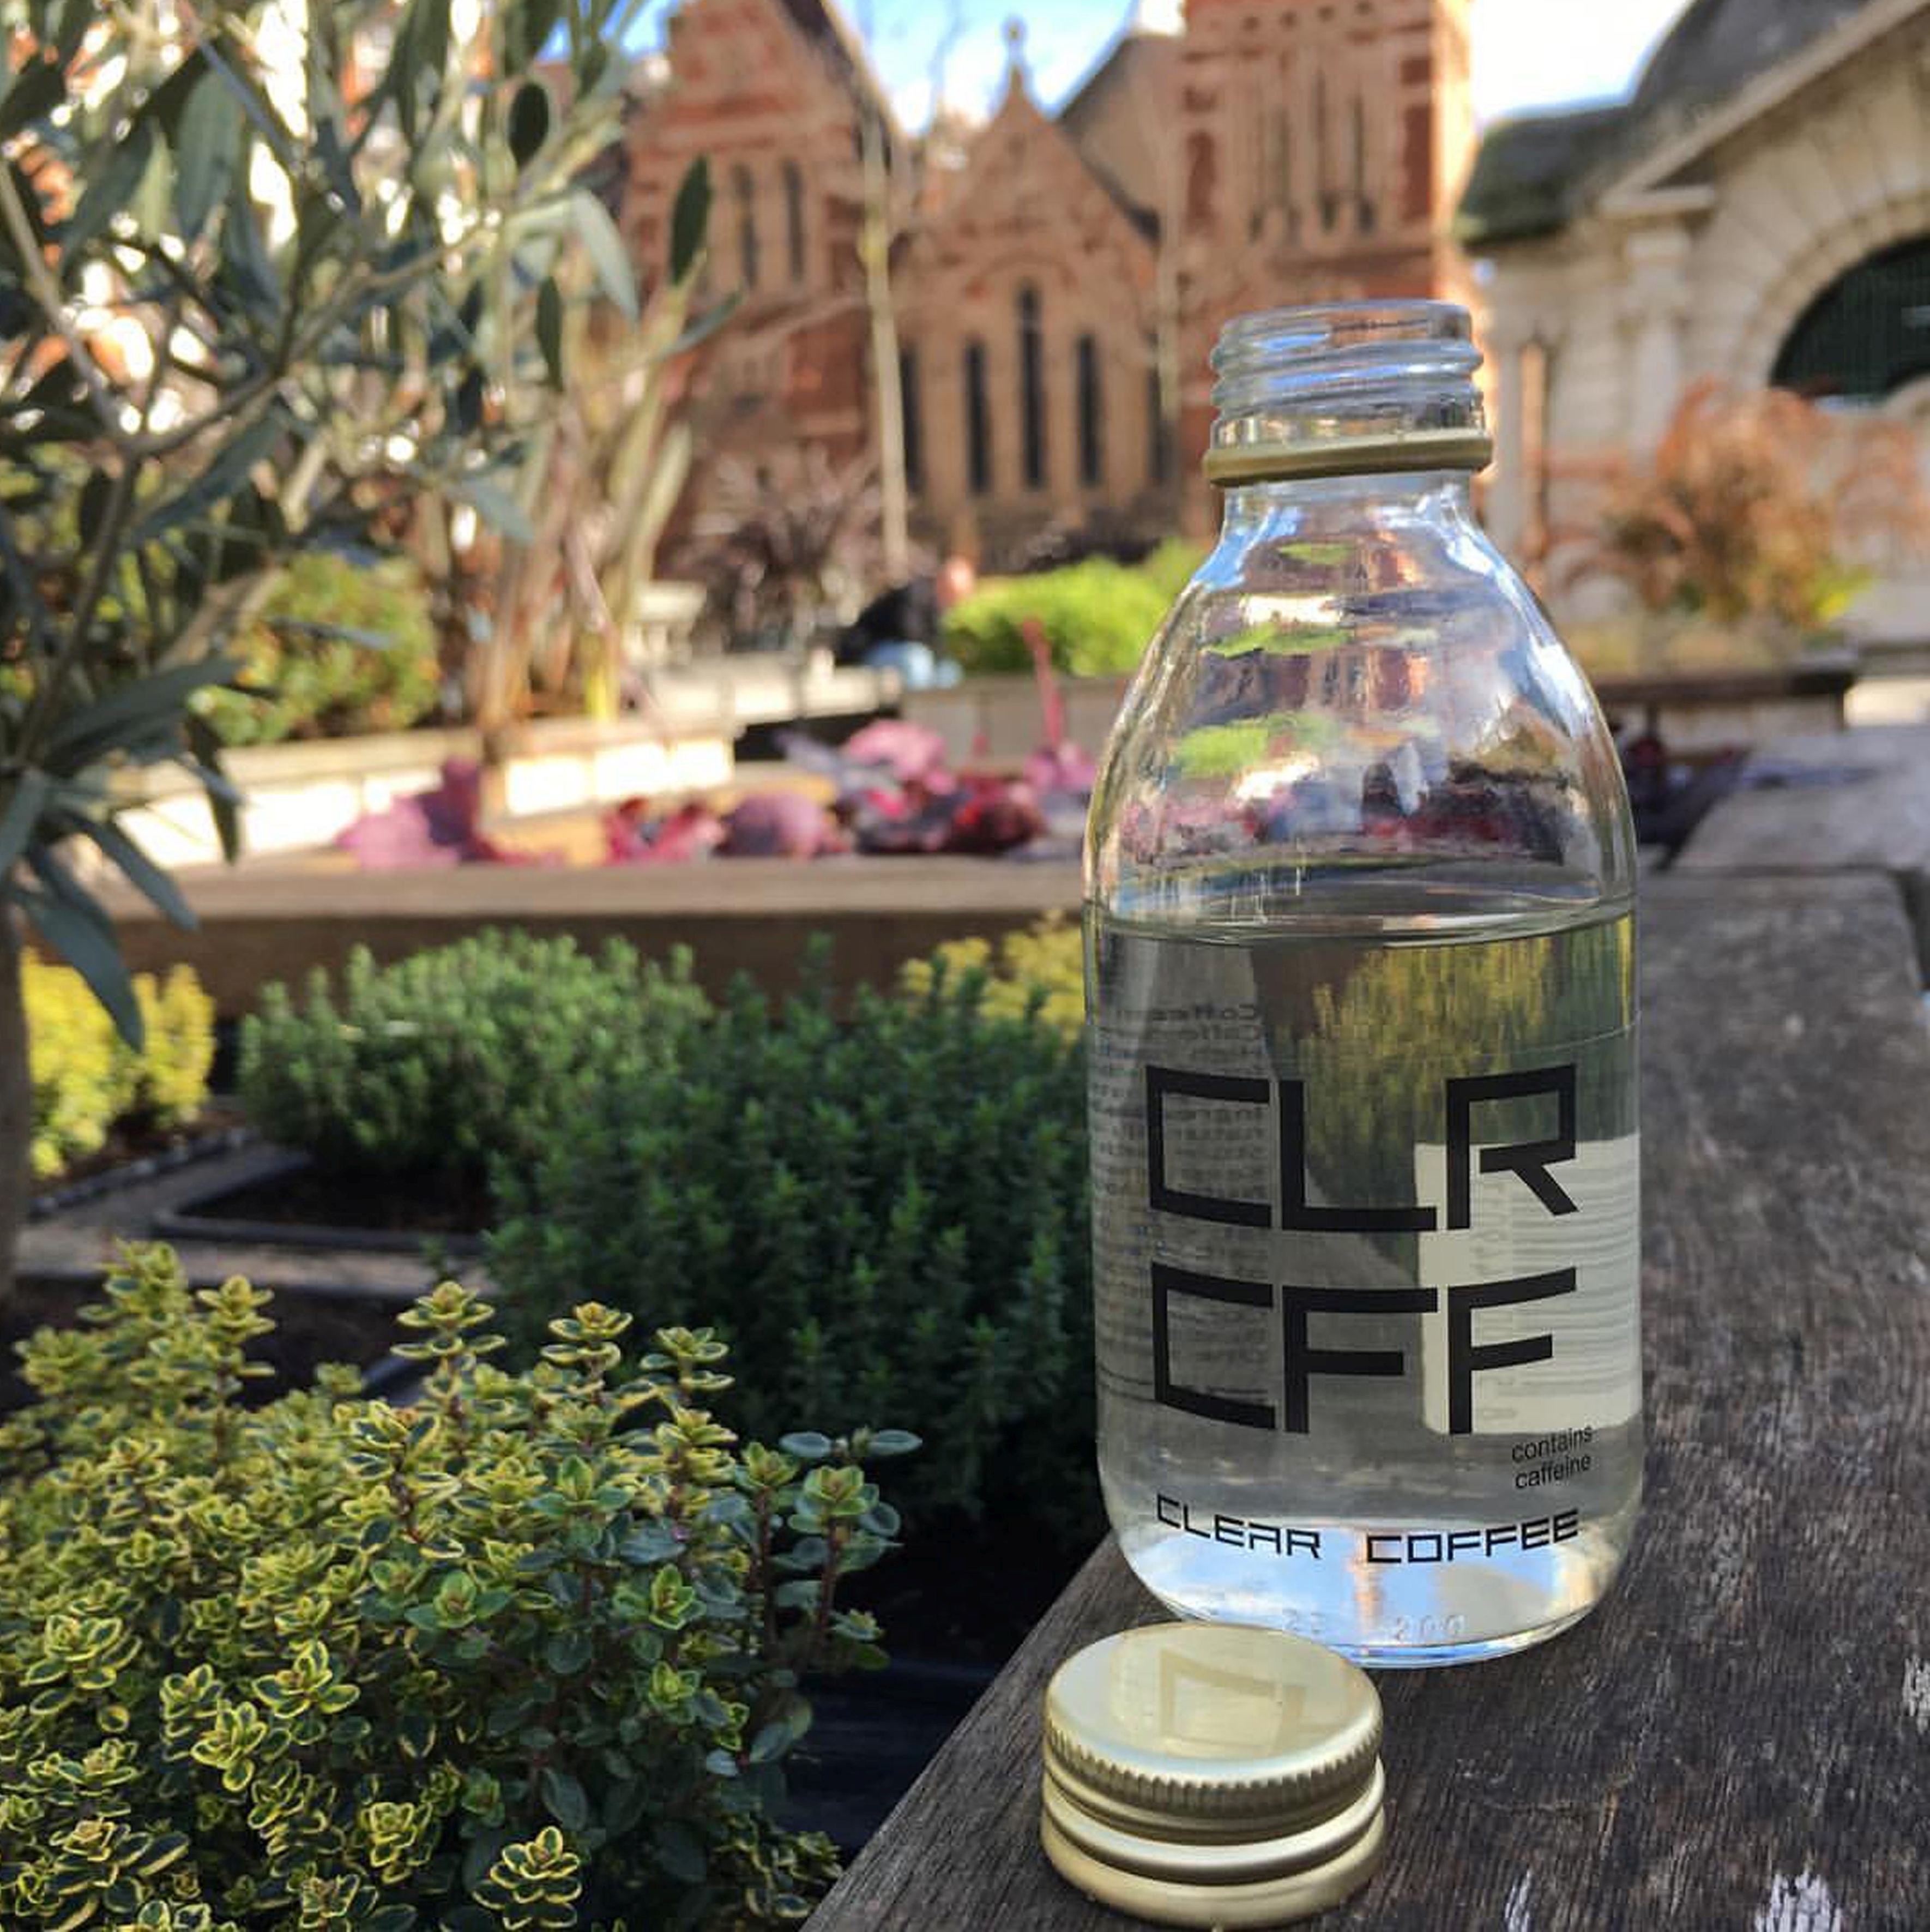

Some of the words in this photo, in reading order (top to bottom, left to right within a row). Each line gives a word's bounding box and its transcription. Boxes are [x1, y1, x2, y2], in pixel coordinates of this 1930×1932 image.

[1146, 1063, 1579, 1231] CLR
[1152, 1262, 1576, 1434] CFF
[1512, 1425, 1593, 1464] contains
[1515, 1454, 1591, 1489] caffeine
[1157, 1493, 1321, 1559] CLEAR
[1367, 1508, 1578, 1563] COFFEE
